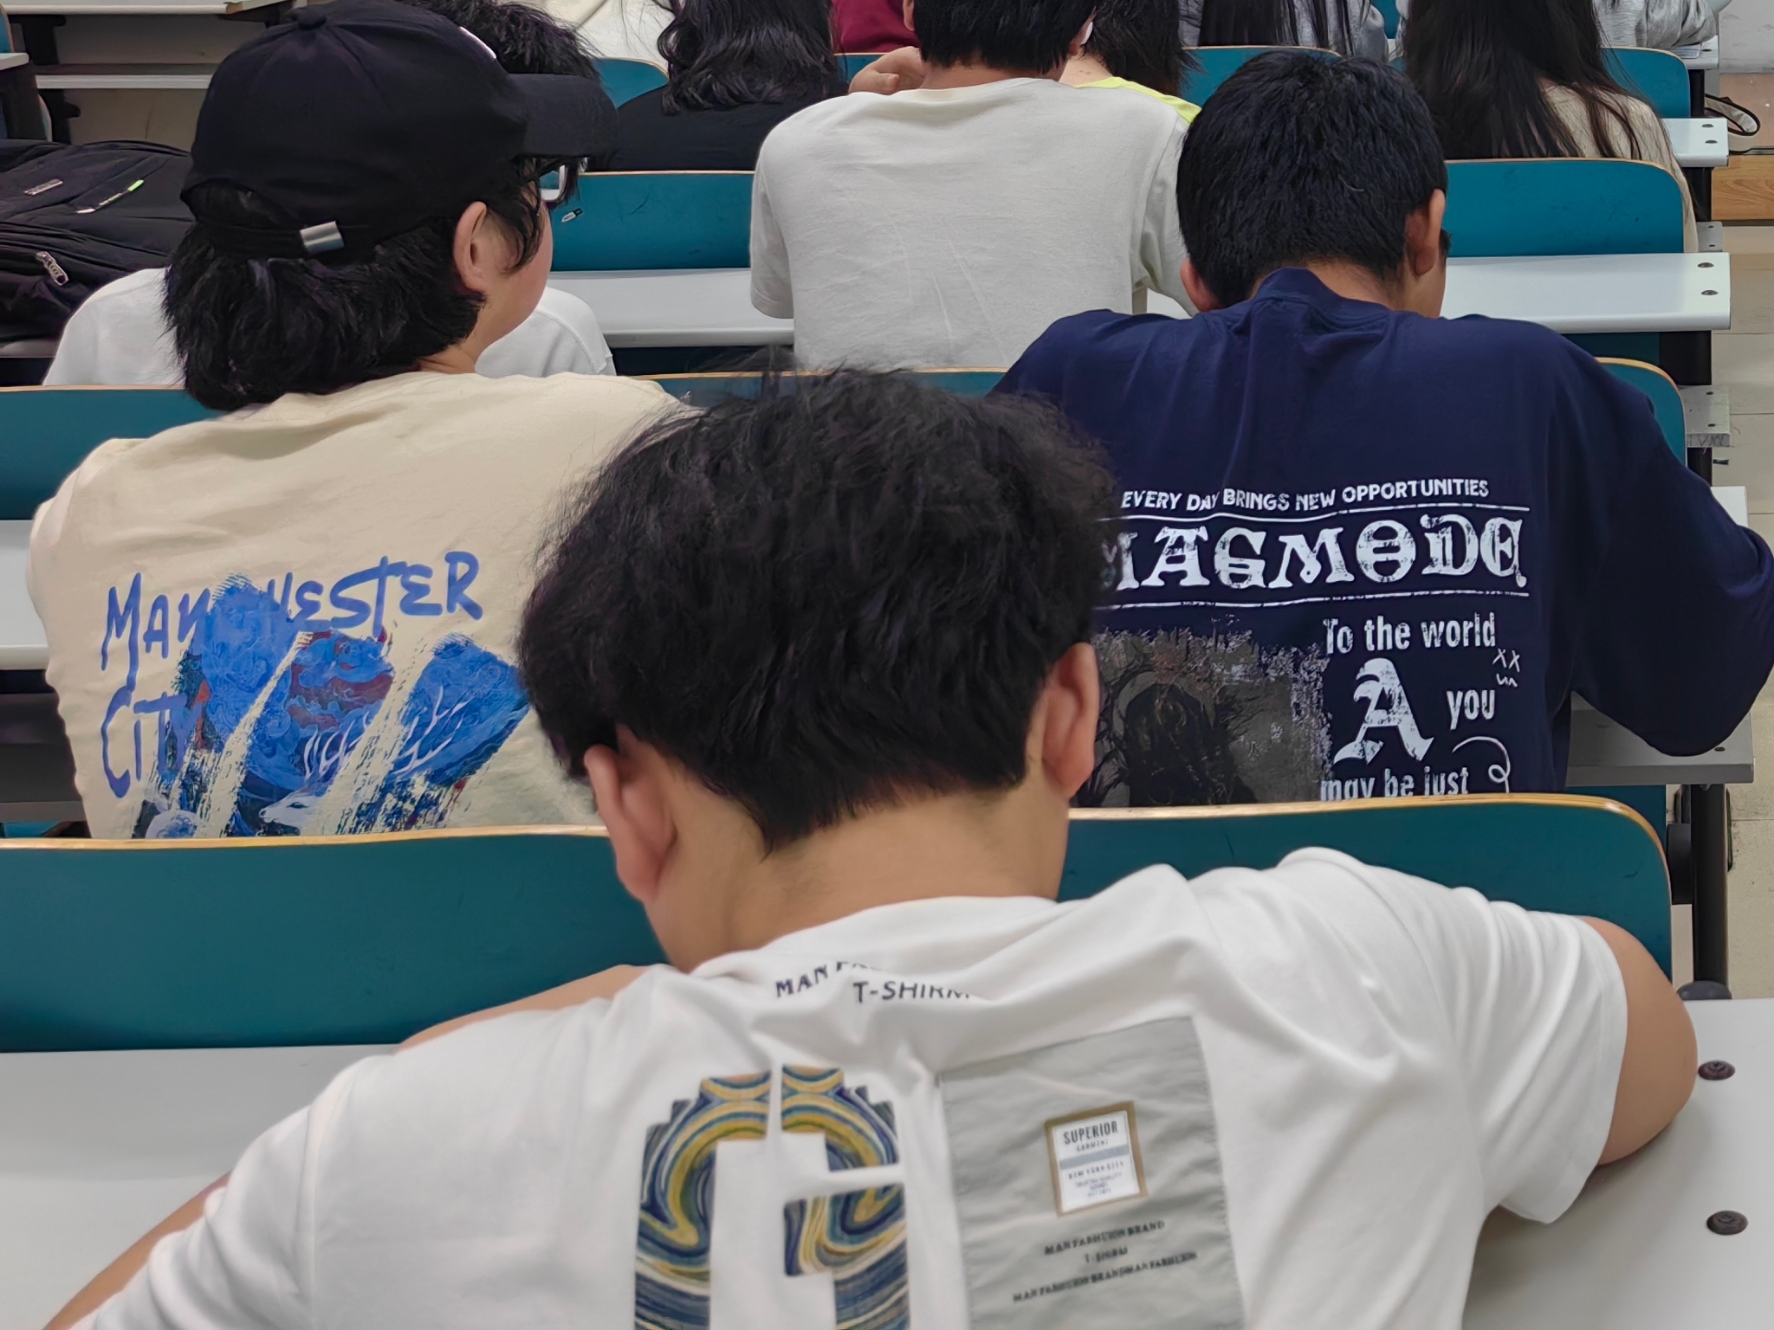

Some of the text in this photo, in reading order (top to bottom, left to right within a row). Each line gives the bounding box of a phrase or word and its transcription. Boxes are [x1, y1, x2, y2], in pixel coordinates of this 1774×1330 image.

[1120, 478, 1489, 512] EVERY DAY BRINGS NEW OPPORTUNITIES
[100, 551, 484, 692] MANHESTER
[1323, 612, 1496, 654] To the world
[1333, 657, 1496, 765] A you
[1320, 765, 1469, 801] may be just
[775, 964, 829, 999] MAN
[1063, 1120, 1118, 1145] SUPERIOR
